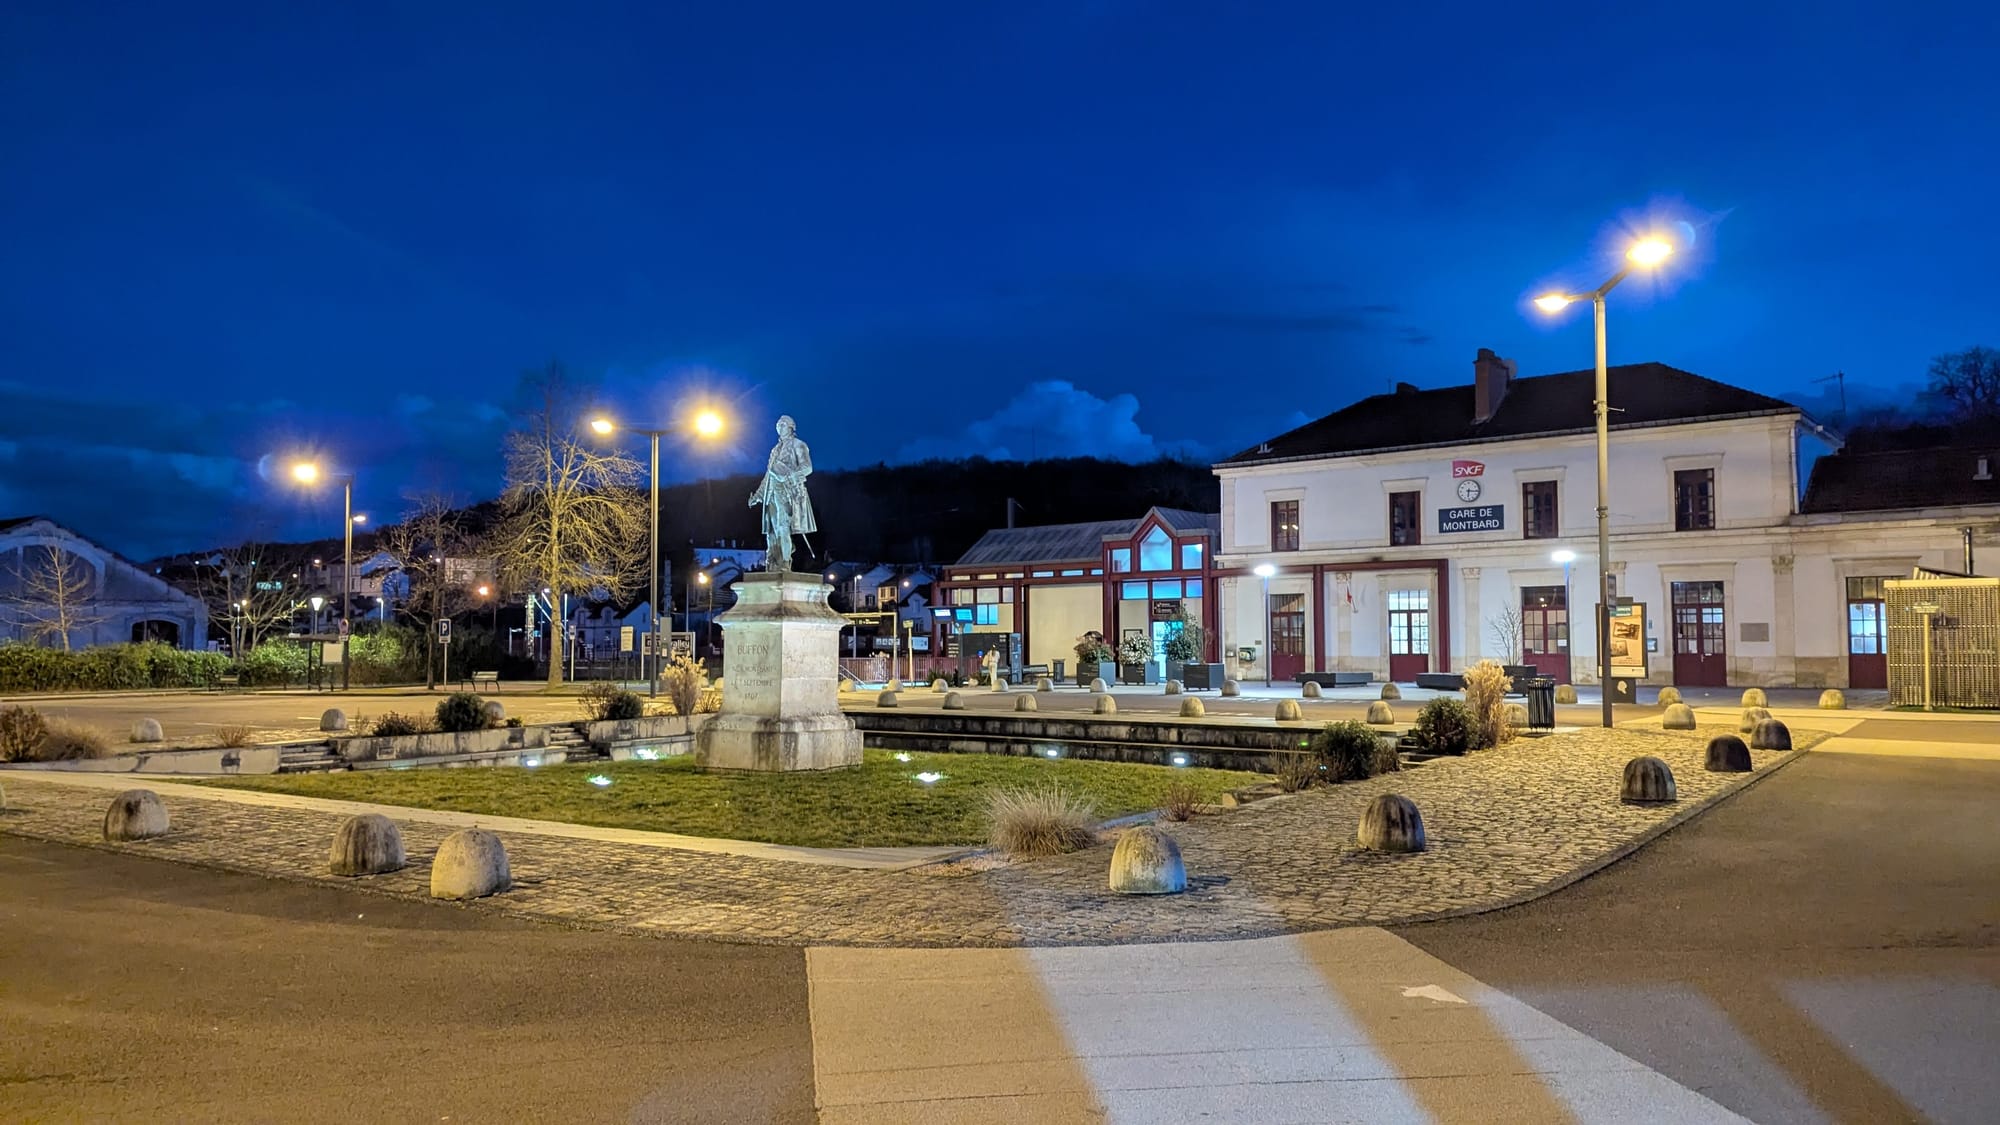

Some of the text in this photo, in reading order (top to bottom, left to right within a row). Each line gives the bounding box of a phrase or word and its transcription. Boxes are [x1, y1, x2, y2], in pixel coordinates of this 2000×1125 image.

[1455, 464, 1483, 476] SNCF
[1449, 508, 1493, 519] GARE DE
[1443, 519, 1500, 531] MONTBARD
[737, 644, 769, 655] BUFFON
